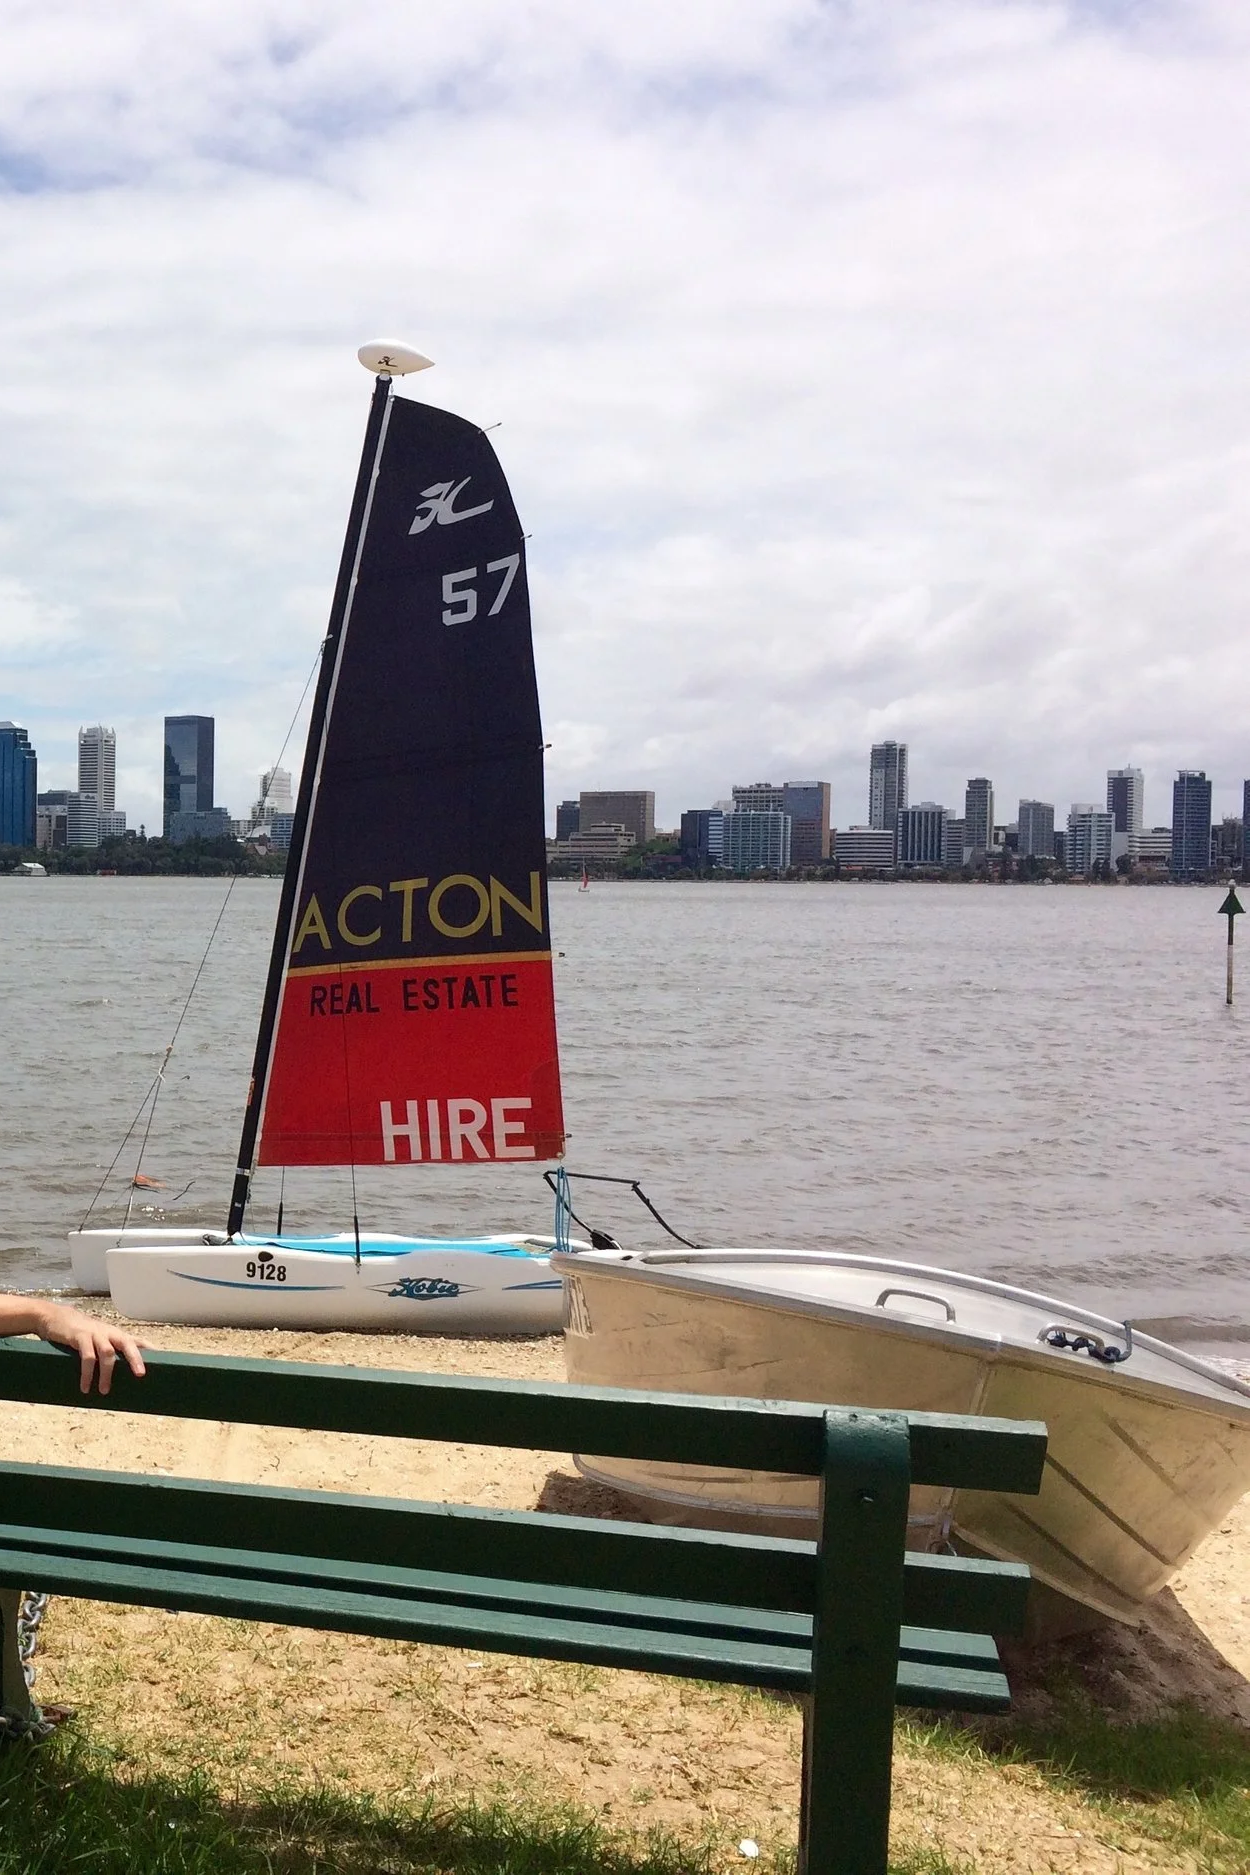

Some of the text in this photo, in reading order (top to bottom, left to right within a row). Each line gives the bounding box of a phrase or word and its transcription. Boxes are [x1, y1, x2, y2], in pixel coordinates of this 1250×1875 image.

[441, 553, 520, 626] 57
[292, 871, 543, 953] ACTON
[310, 974, 519, 1017] REAL ESTATE
[379, 1096, 536, 1162] HIRE
[246, 1261, 287, 1282] 9128
